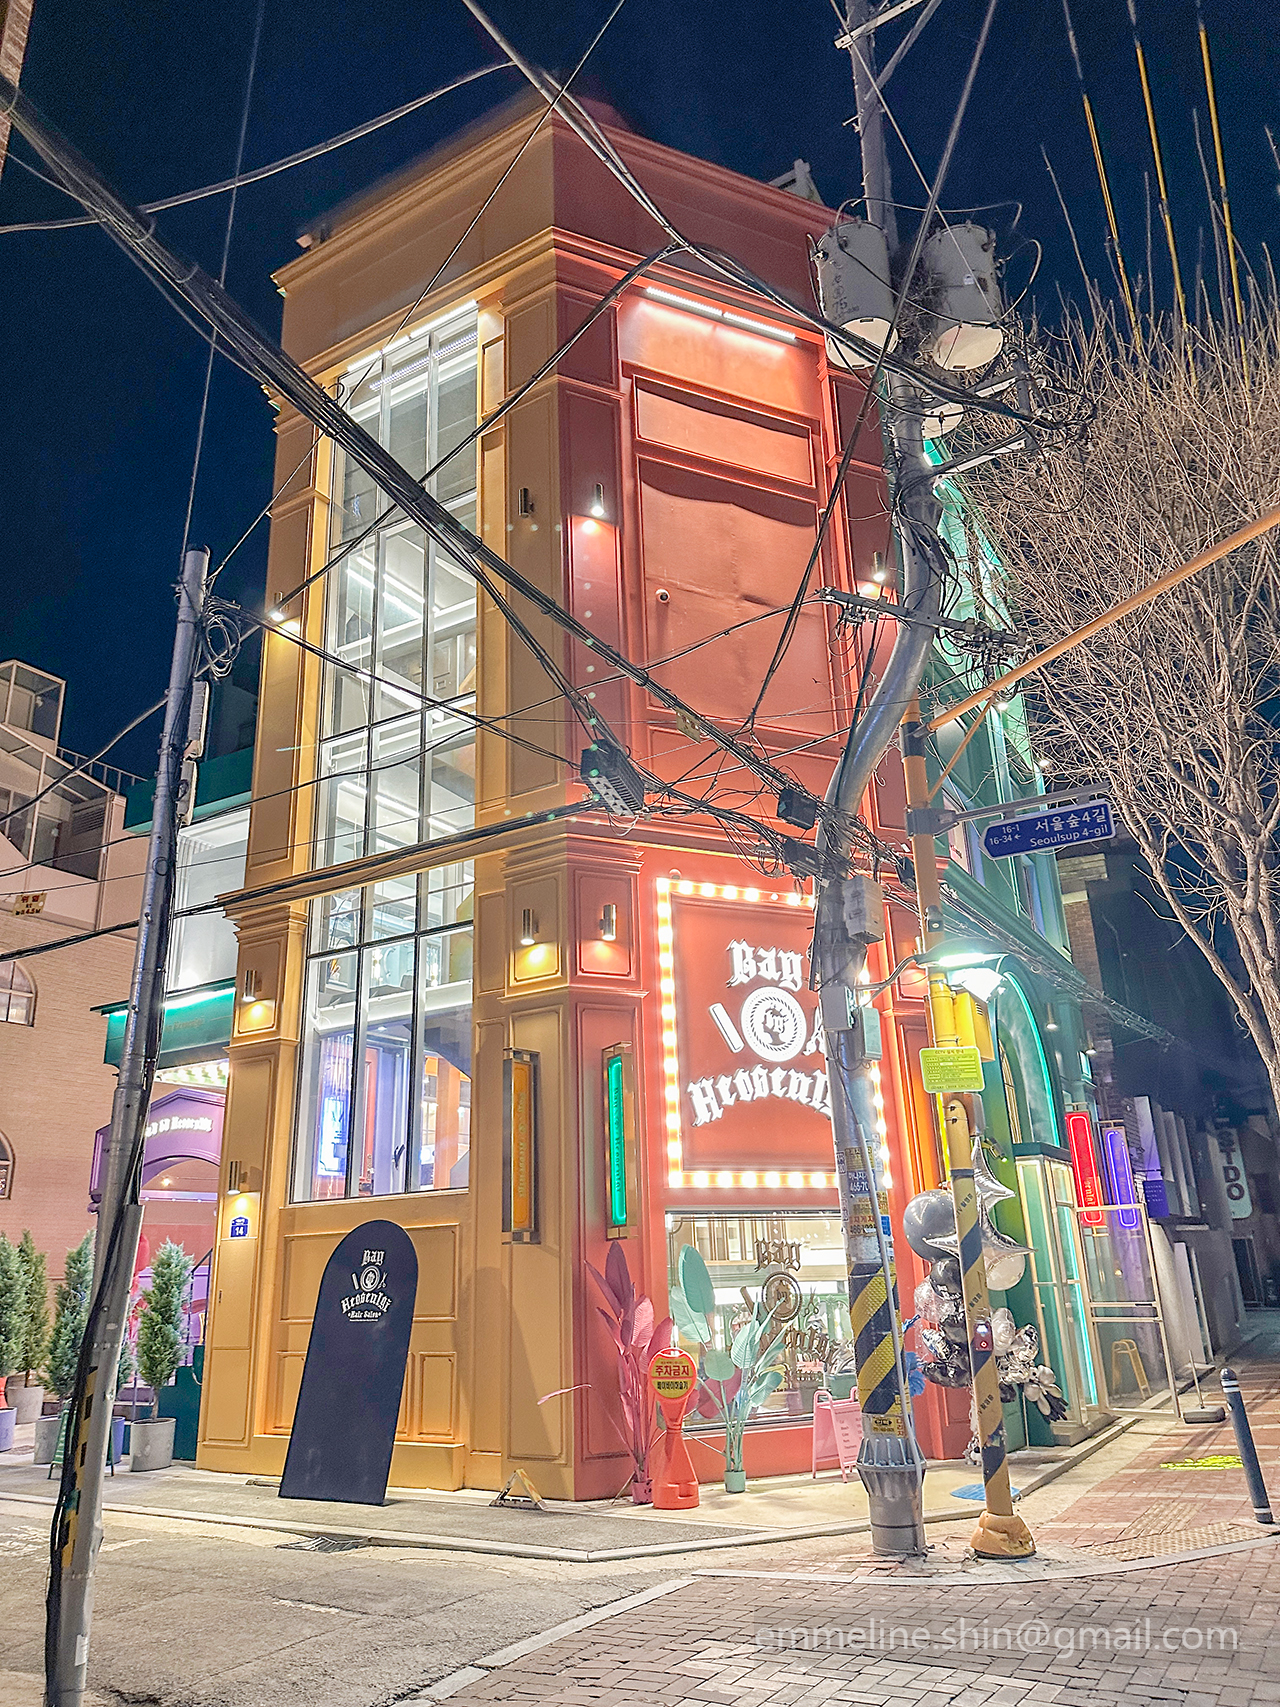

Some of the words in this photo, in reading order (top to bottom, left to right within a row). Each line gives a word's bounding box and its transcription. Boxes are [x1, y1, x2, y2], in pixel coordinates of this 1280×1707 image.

[1002, 824, 1020, 834] 16-1
[1035, 807, 1107, 833] 서울숲4길
[990, 835, 1012, 846] 16-34
[1030, 831, 1080, 847] Seoulsup
[1082, 825, 1108, 837] 4-gil
[726, 939, 804, 992] Bay
[234, 1226, 244, 1236] 14
[361, 1249, 385, 1267] Bay
[754, 1238, 803, 1273] Bay
[655, 1365, 690, 1377] 주차금지
